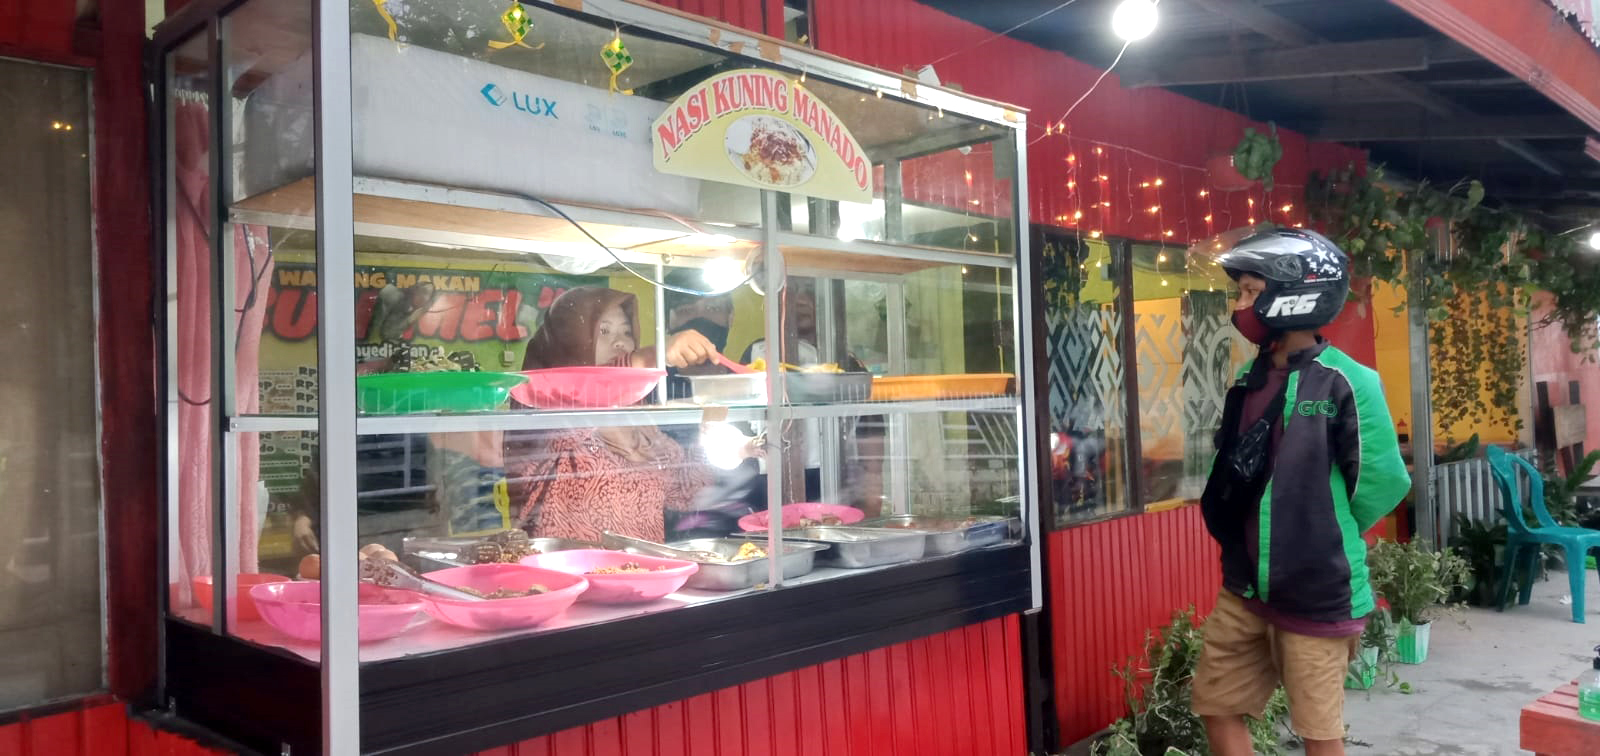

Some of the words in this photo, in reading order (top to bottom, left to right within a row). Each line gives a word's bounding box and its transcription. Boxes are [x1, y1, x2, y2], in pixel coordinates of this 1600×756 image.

[512, 91, 559, 119] LUX
[657, 87, 711, 160] NASI
[712, 74, 788, 116] KUNING
[792, 87, 868, 190] MANADO
[1265, 293, 1322, 317] R6
